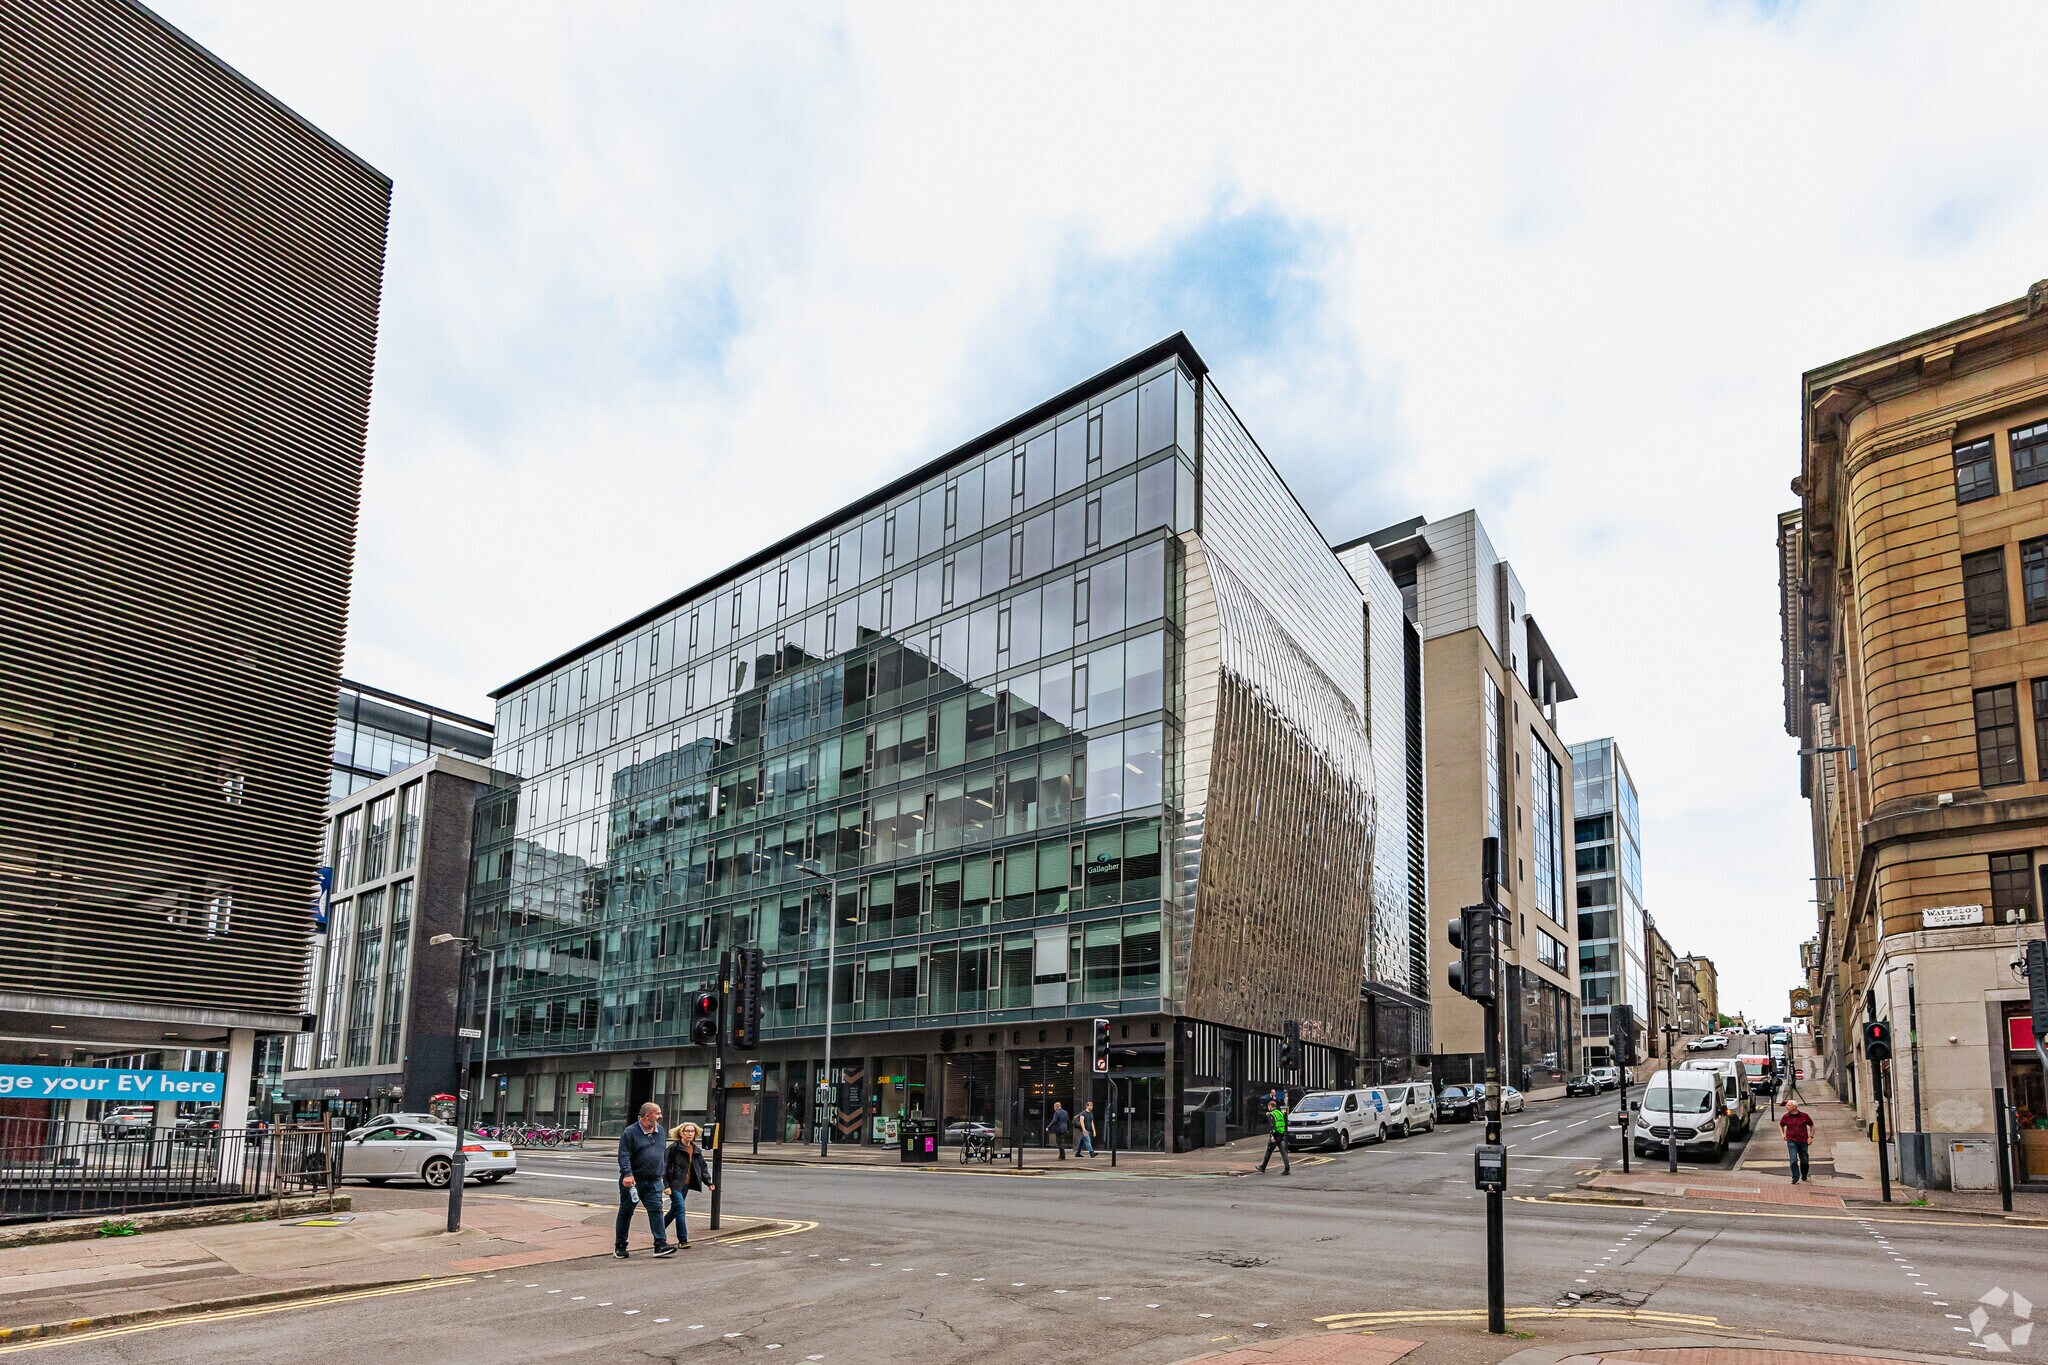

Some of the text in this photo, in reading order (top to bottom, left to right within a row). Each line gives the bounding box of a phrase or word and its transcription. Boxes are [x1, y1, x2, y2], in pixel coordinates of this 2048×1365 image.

[1087, 863, 1119, 873] Gallagher
[1926, 907, 1978, 916] WATERLOO
[1934, 914, 1971, 922] STREET
[877, 1075, 906, 1084] SUBWAY
[43, 1077, 109, 1095] your
[118, 1075, 153, 1092] EV
[160, 1074, 216, 1094] here
[813, 1126, 832, 1144] ROL
